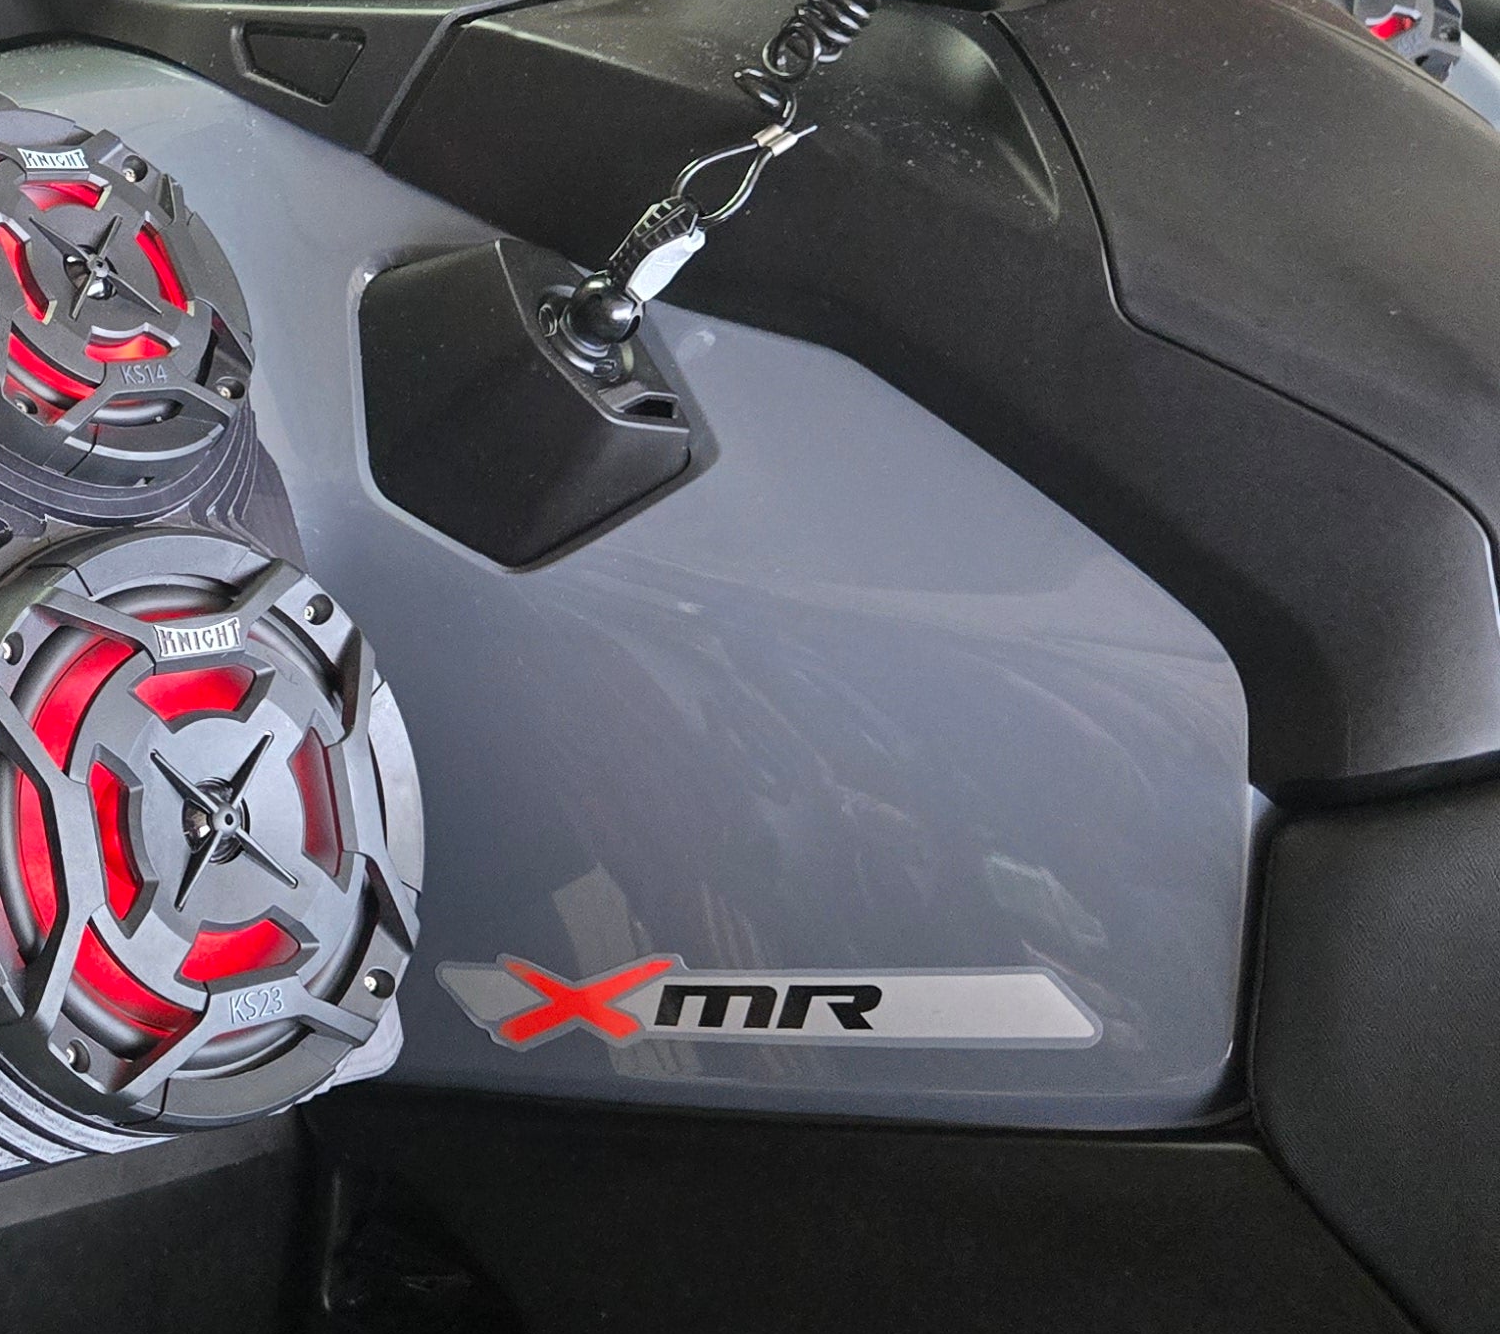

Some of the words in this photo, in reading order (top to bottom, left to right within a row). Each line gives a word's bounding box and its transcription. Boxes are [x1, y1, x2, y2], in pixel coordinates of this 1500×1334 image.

[22, 151, 86, 167] KNIGHT
[120, 364, 167, 384] KS14
[159, 618, 240, 655] KNIGHT
[229, 986, 285, 1024] KS23
